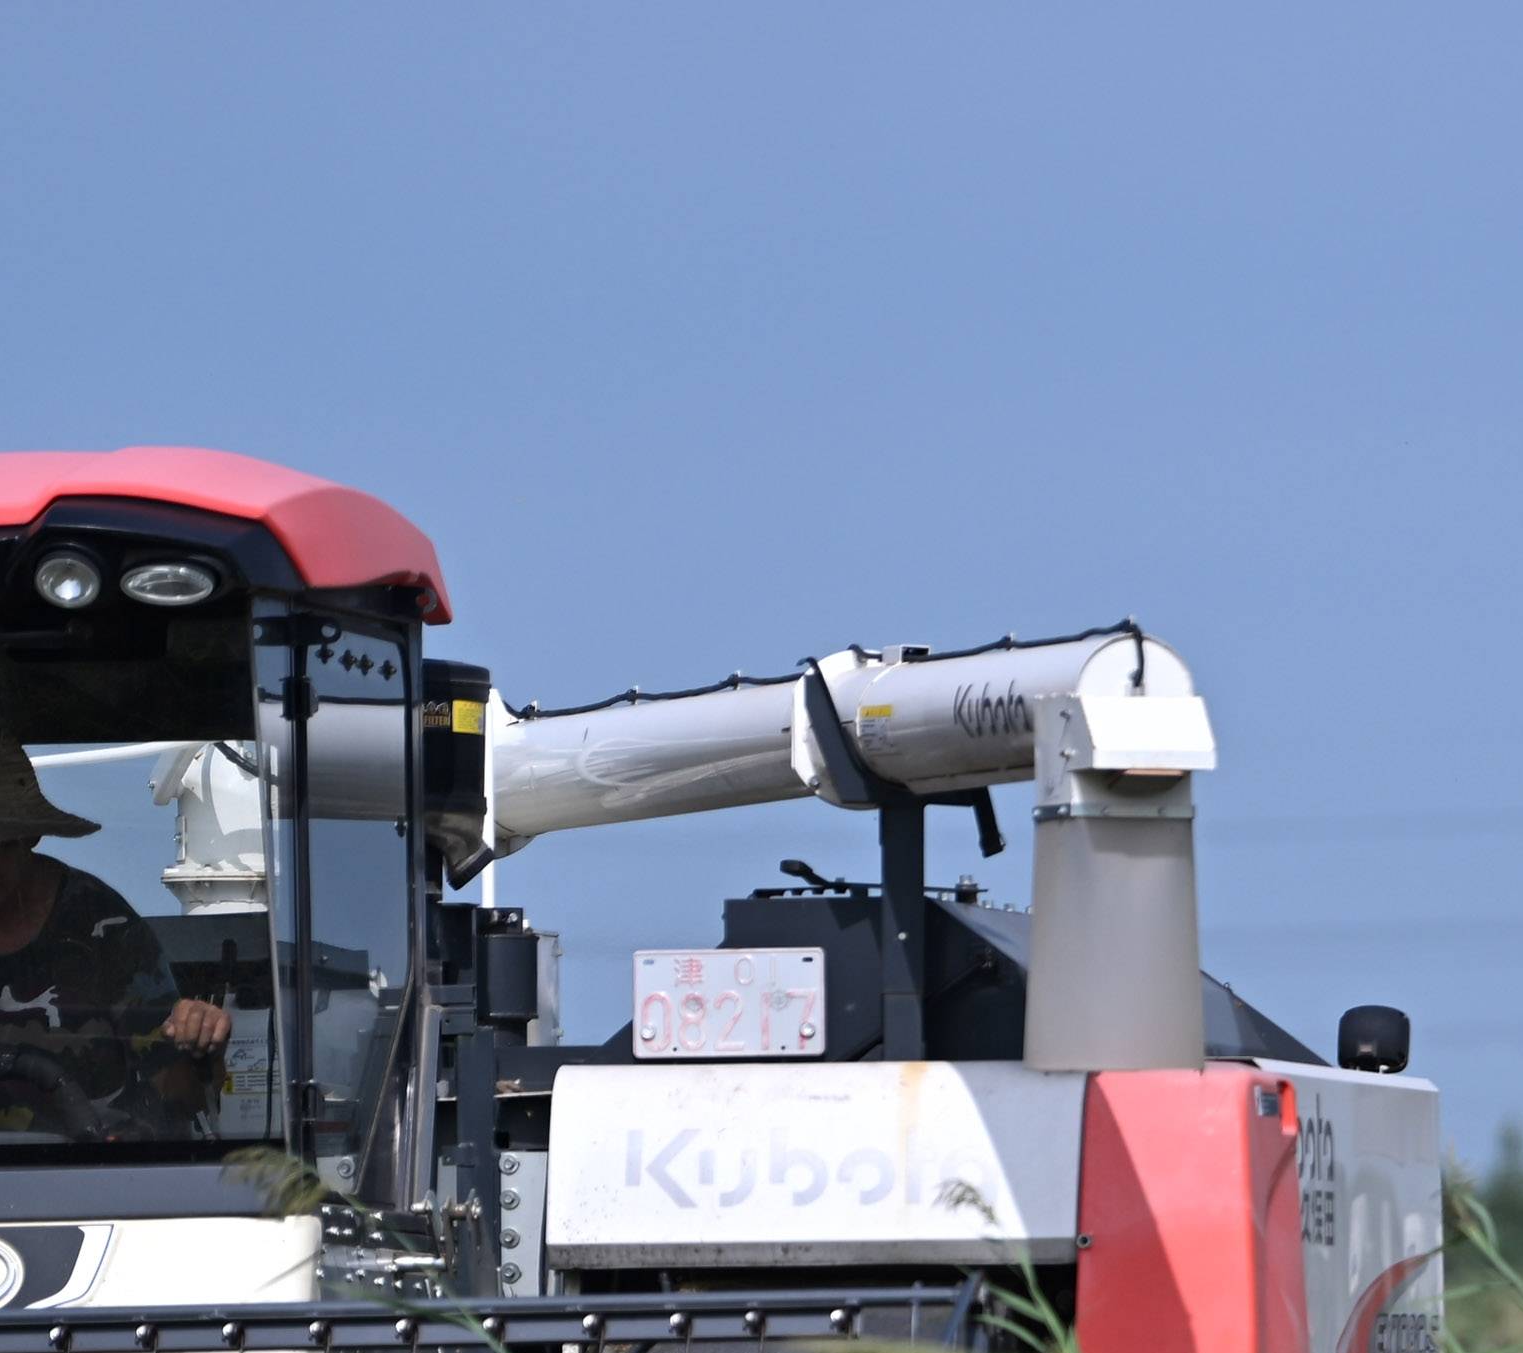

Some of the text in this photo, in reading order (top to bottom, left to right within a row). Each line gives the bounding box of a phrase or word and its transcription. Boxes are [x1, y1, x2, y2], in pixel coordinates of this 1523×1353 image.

[953, 679, 1034, 738] Kubota
[673, 958, 704, 987] 津
[640, 990, 816, 1051] 08217
[624, 1127, 1001, 1208] Kubota
